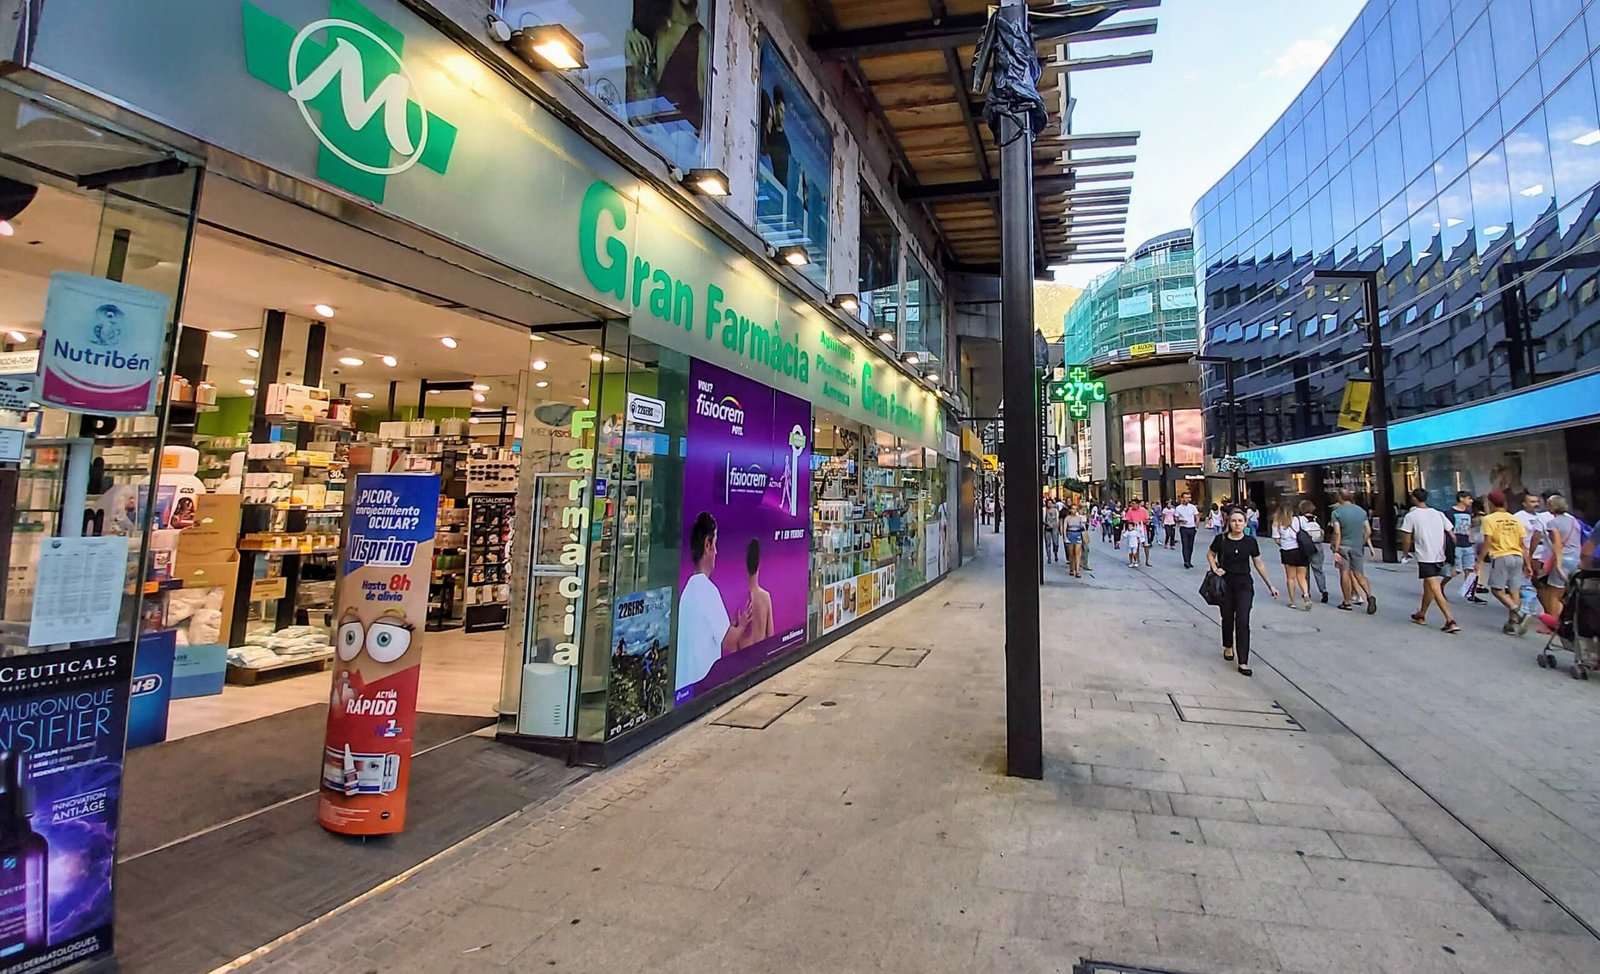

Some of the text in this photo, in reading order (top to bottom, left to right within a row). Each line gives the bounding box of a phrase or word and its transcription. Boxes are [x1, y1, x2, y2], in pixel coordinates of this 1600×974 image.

[579, 180, 809, 384] Gran Farmàcia
[53, 338, 150, 371] Nutribén
[1055, 382, 1105, 401] +27°C
[697, 394, 744, 424] fisiocrem
[730, 467, 767, 488] fisiocrem
[357, 489, 400, 507] ¿PICOR y
[355, 505, 420, 518] enrojecimiento
[368, 517, 420, 530] OCULAR?
[552, 410, 597, 666] Farmàcia
[350, 534, 418, 567] Vispring
[362, 574, 411, 592] Hasta 8h
[365, 591, 403, 602] de alivio
[618, 599, 645, 620] 226ERS
[0, 655, 118, 683] CEUTICALS
[375, 688, 398, 699] ACTÚA
[346, 695, 398, 716] RÁPIDO
[52, 791, 107, 812] INNOVATION
[52, 799, 105, 822] ANTI-ÂGE
